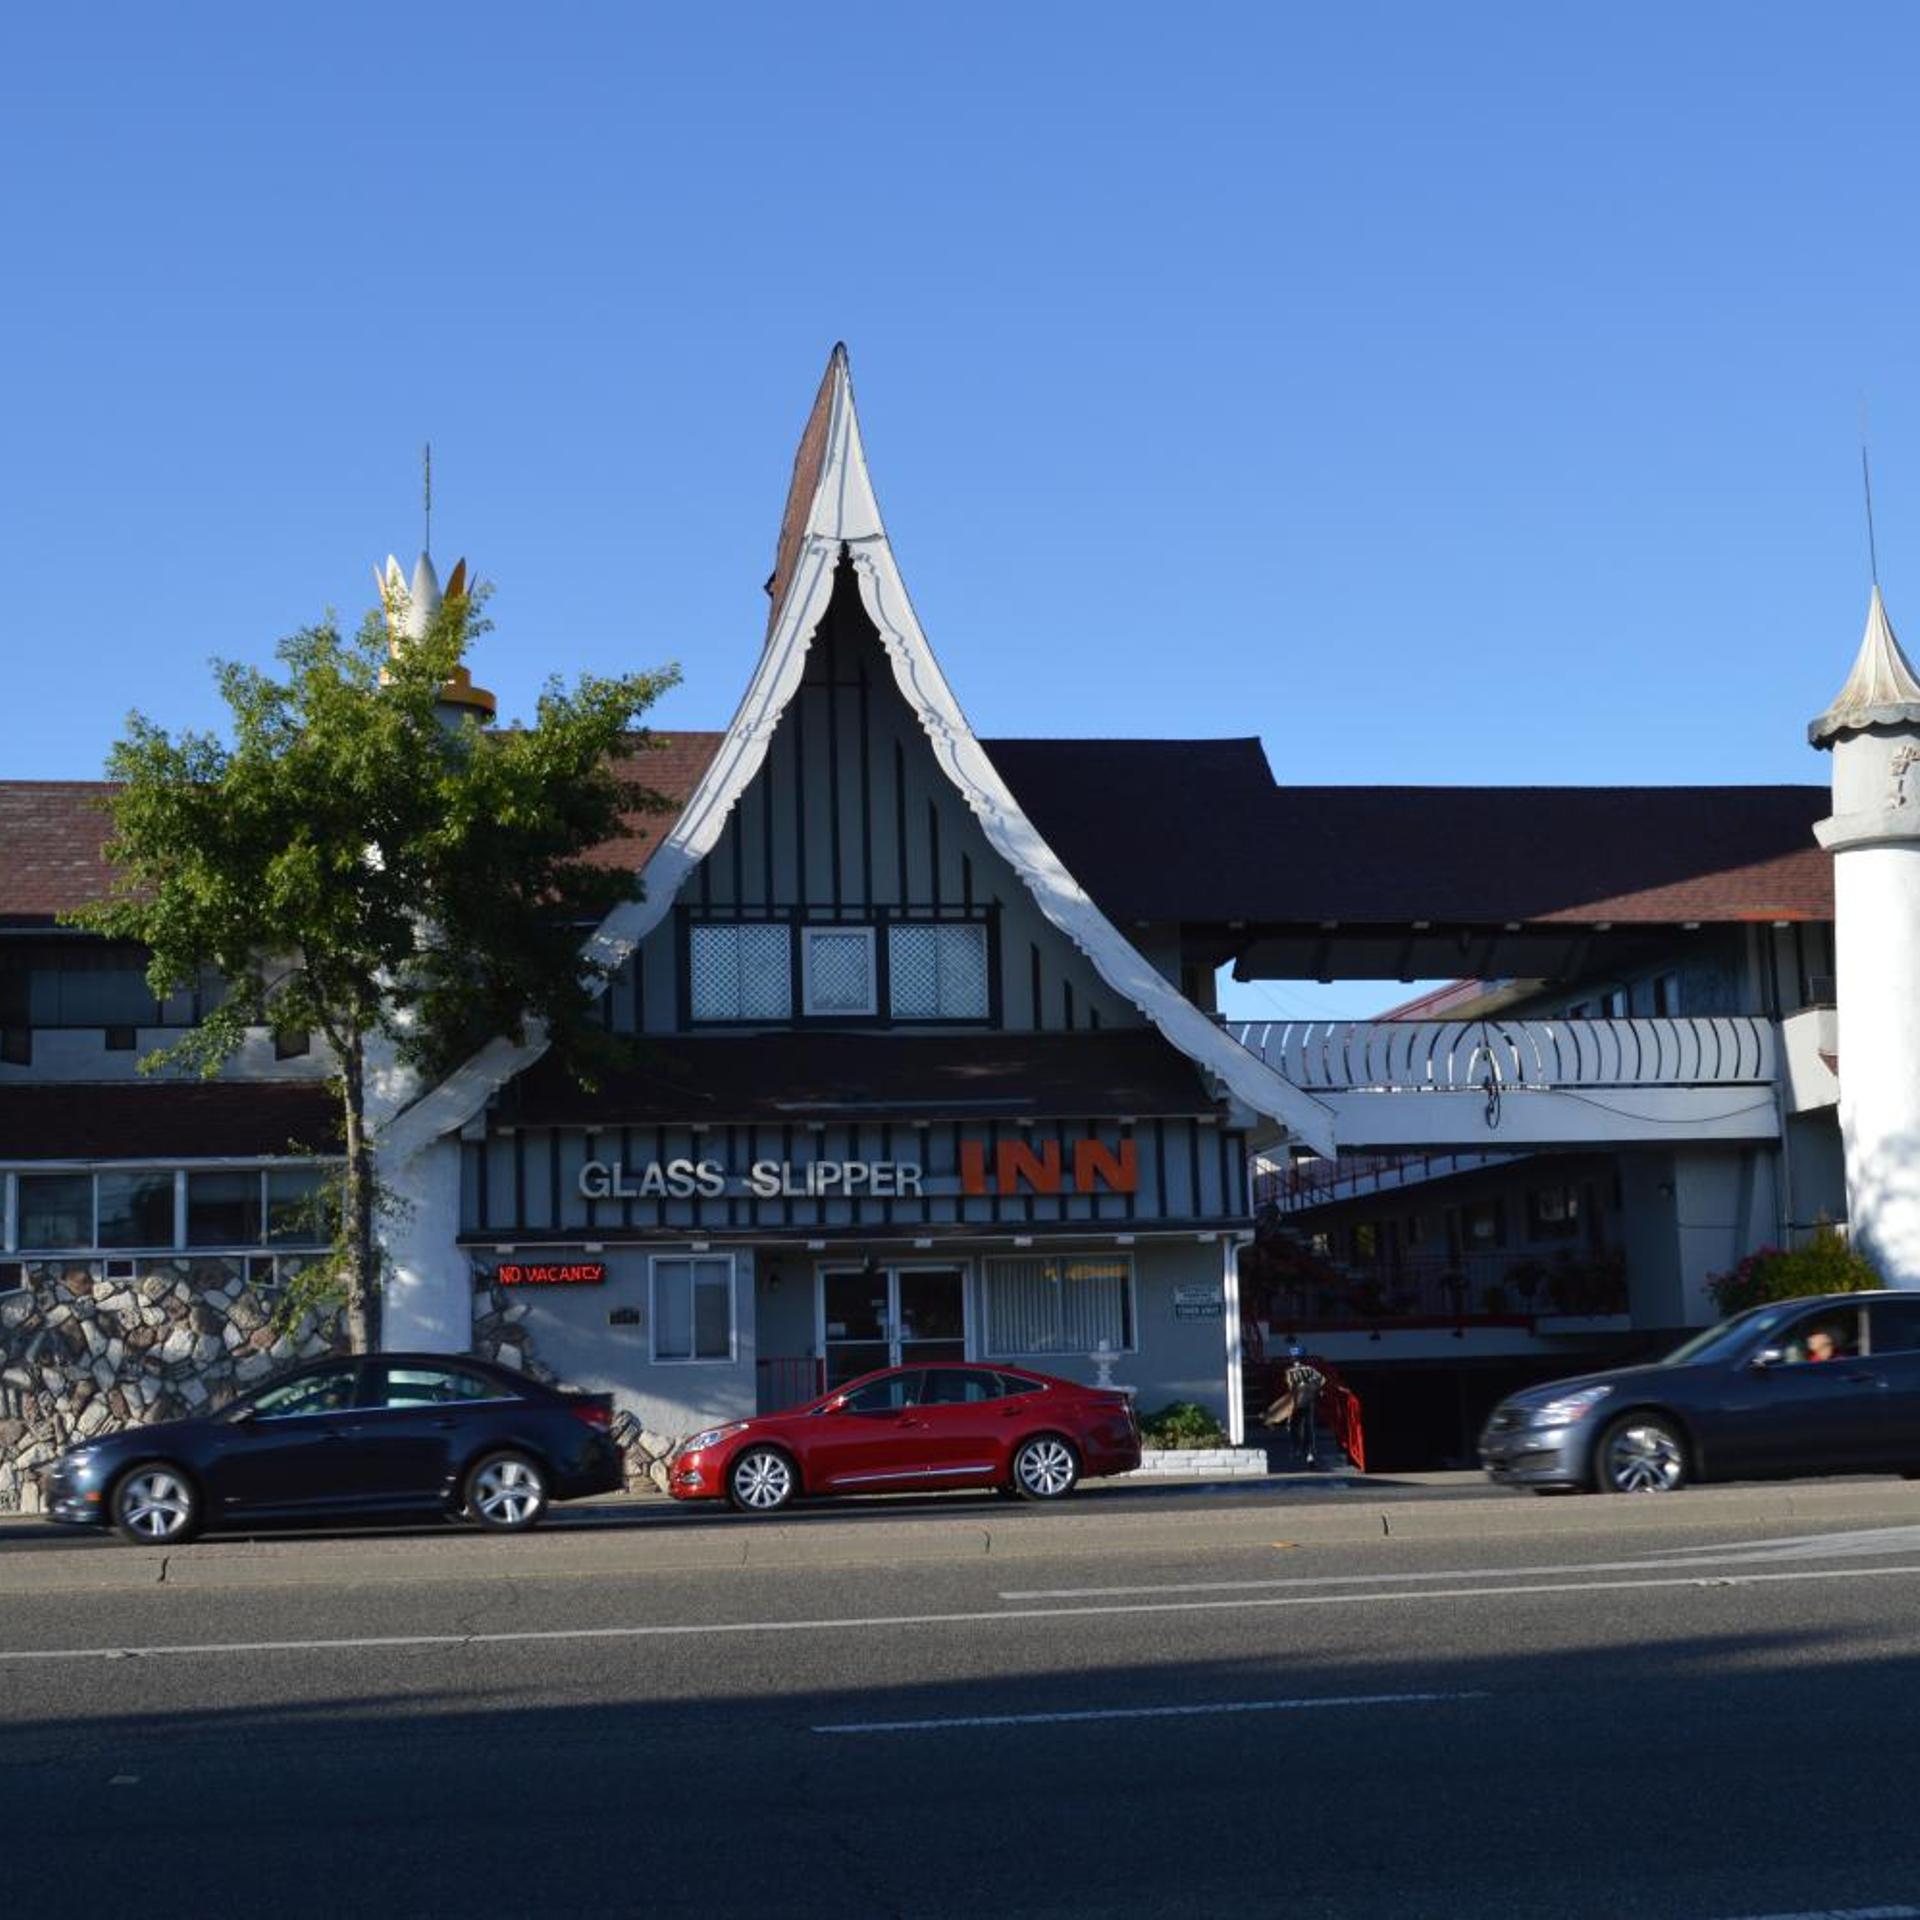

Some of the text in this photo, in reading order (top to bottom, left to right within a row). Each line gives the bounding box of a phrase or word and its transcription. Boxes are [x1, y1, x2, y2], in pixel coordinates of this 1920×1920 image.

[579, 1139, 1137, 1198] GLASS SLIPPER INN
[500, 1265, 602, 1283] NO VACANCY
